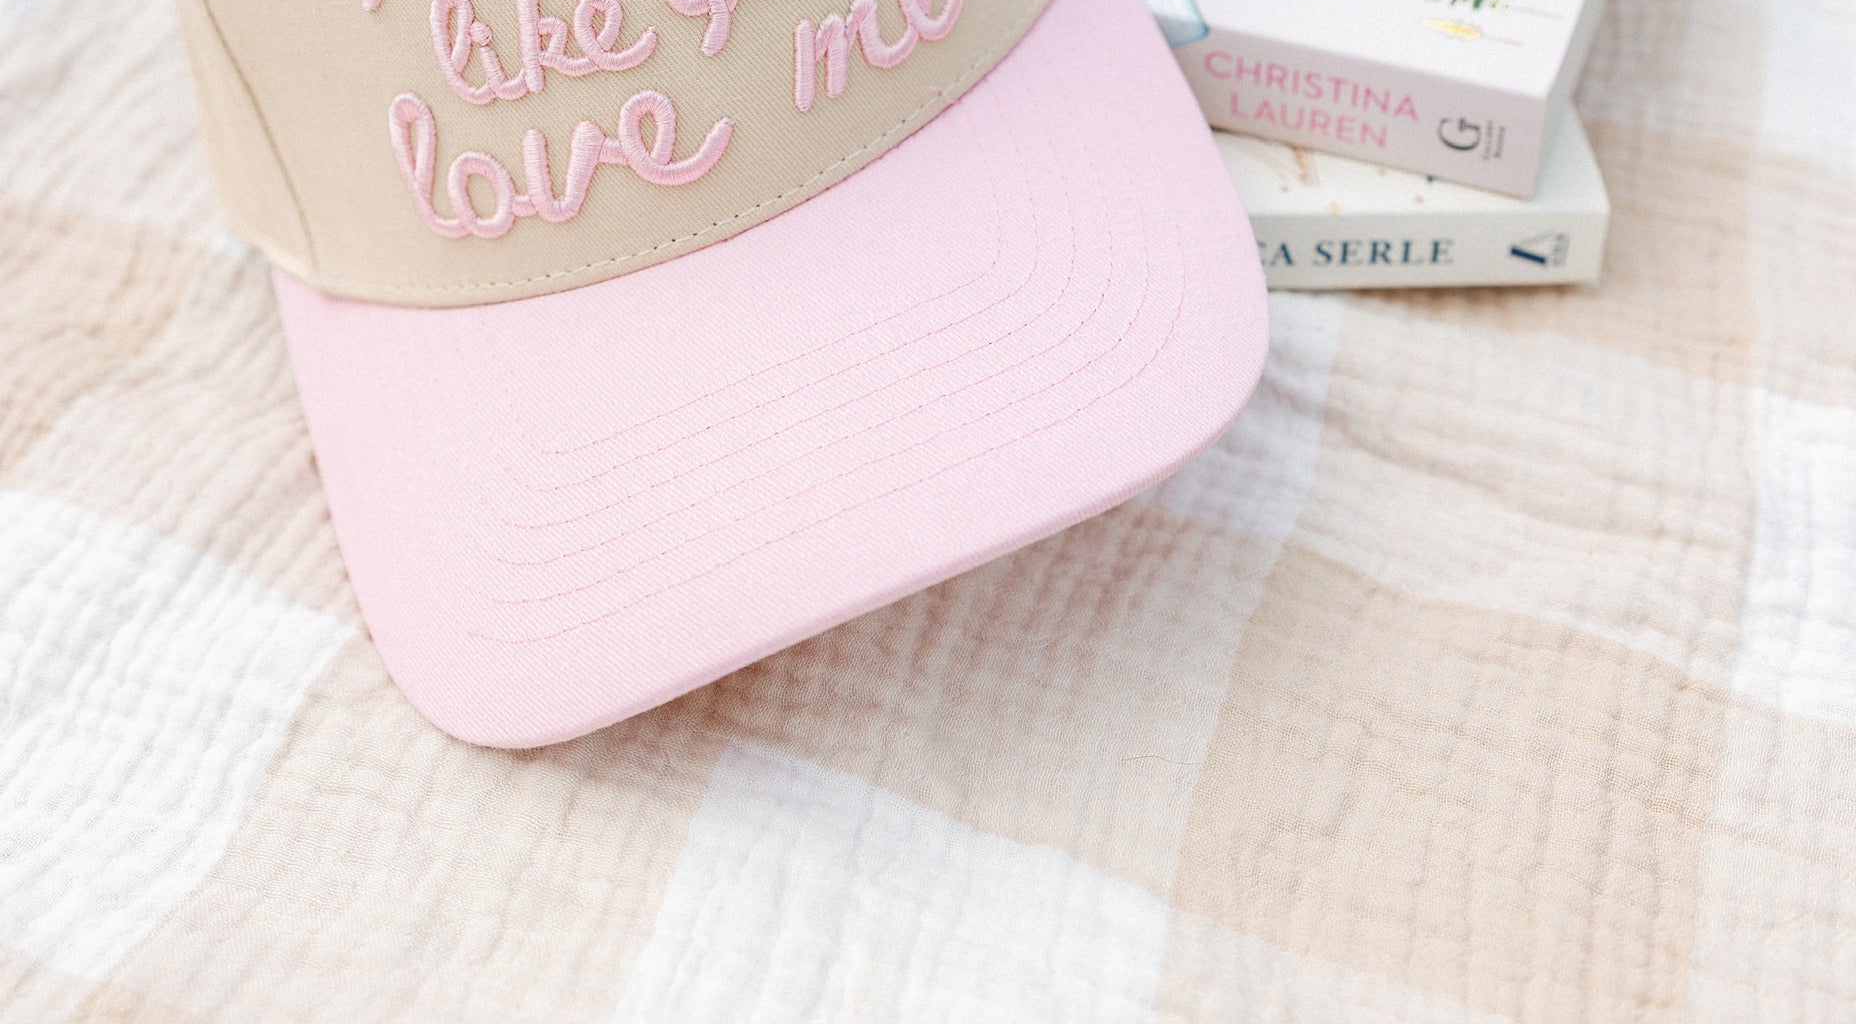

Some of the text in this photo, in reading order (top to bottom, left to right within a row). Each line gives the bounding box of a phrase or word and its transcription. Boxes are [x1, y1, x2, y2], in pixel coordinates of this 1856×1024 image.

[1204, 51, 1419, 122] CHRISTINA
[1229, 92, 1389, 149] LAUREN
[1438, 117, 1481, 151] G
[388, 91, 735, 240] love
[1313, 240, 1455, 267] SERLE
